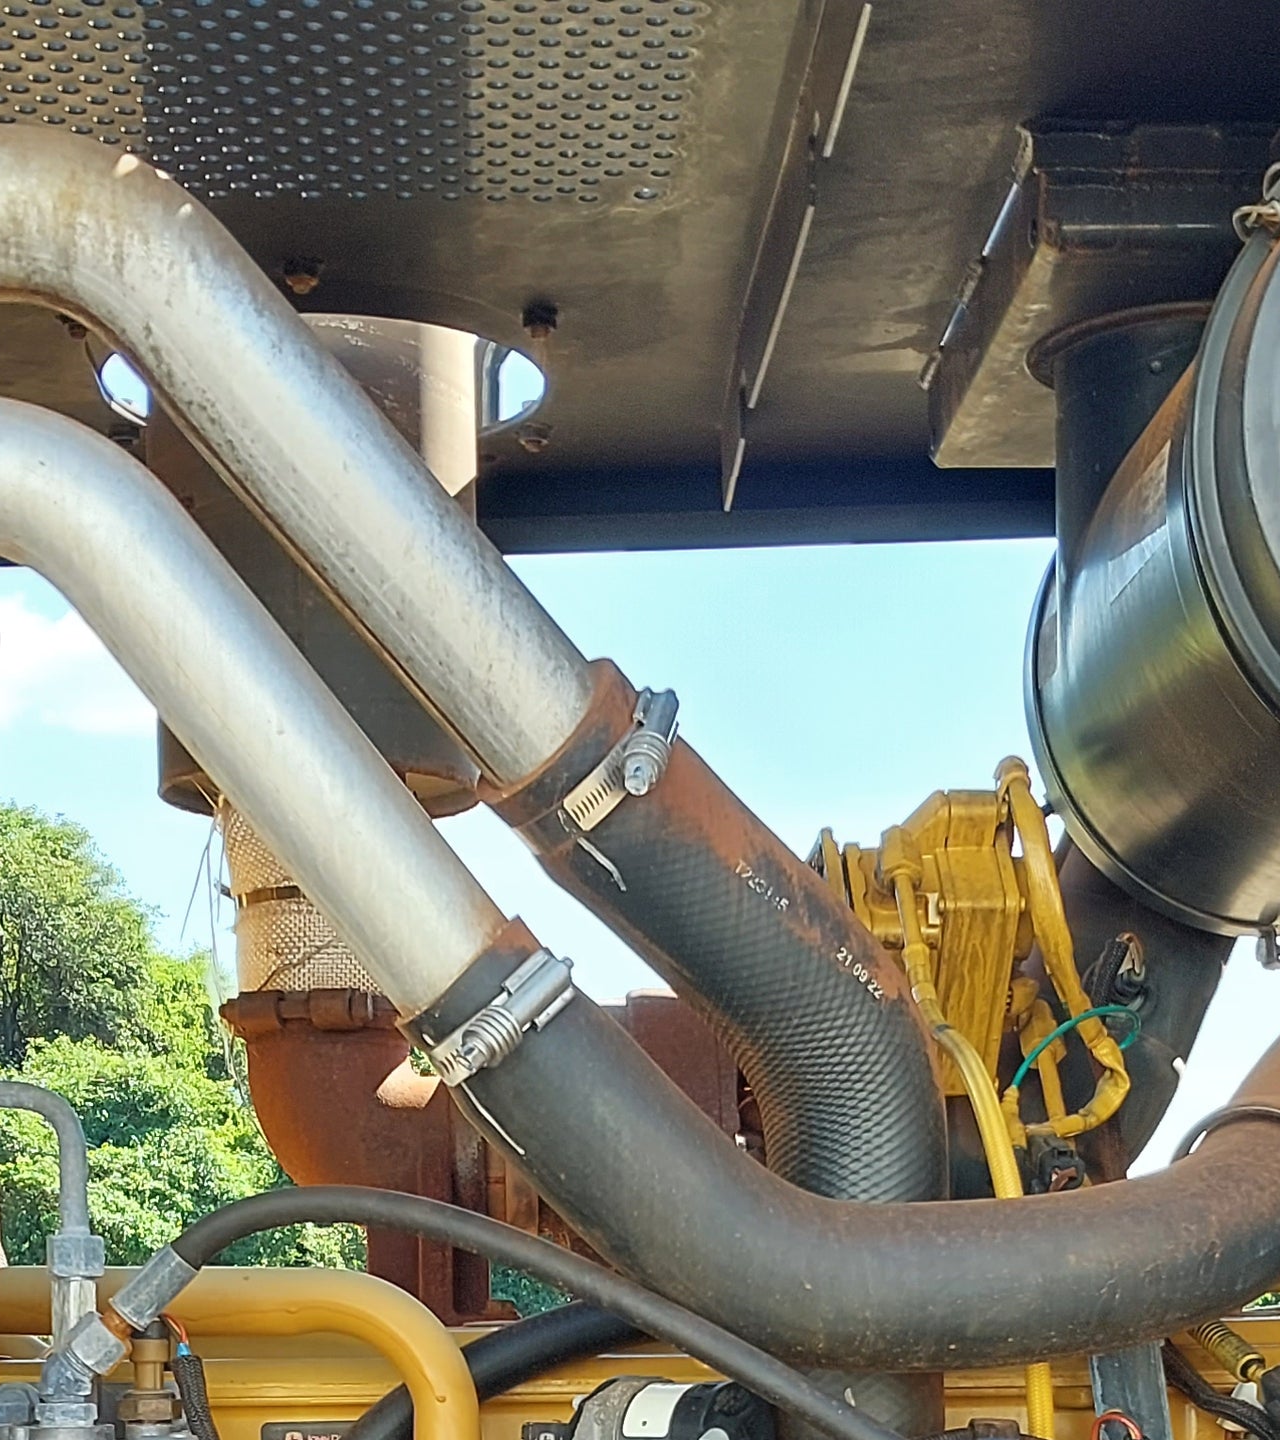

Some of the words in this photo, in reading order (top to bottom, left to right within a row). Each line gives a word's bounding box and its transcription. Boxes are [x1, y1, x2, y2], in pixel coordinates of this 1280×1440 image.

[836, 947, 853, 966] 21
[852, 963, 869, 983] 09
[867, 979, 884, 999] 22
